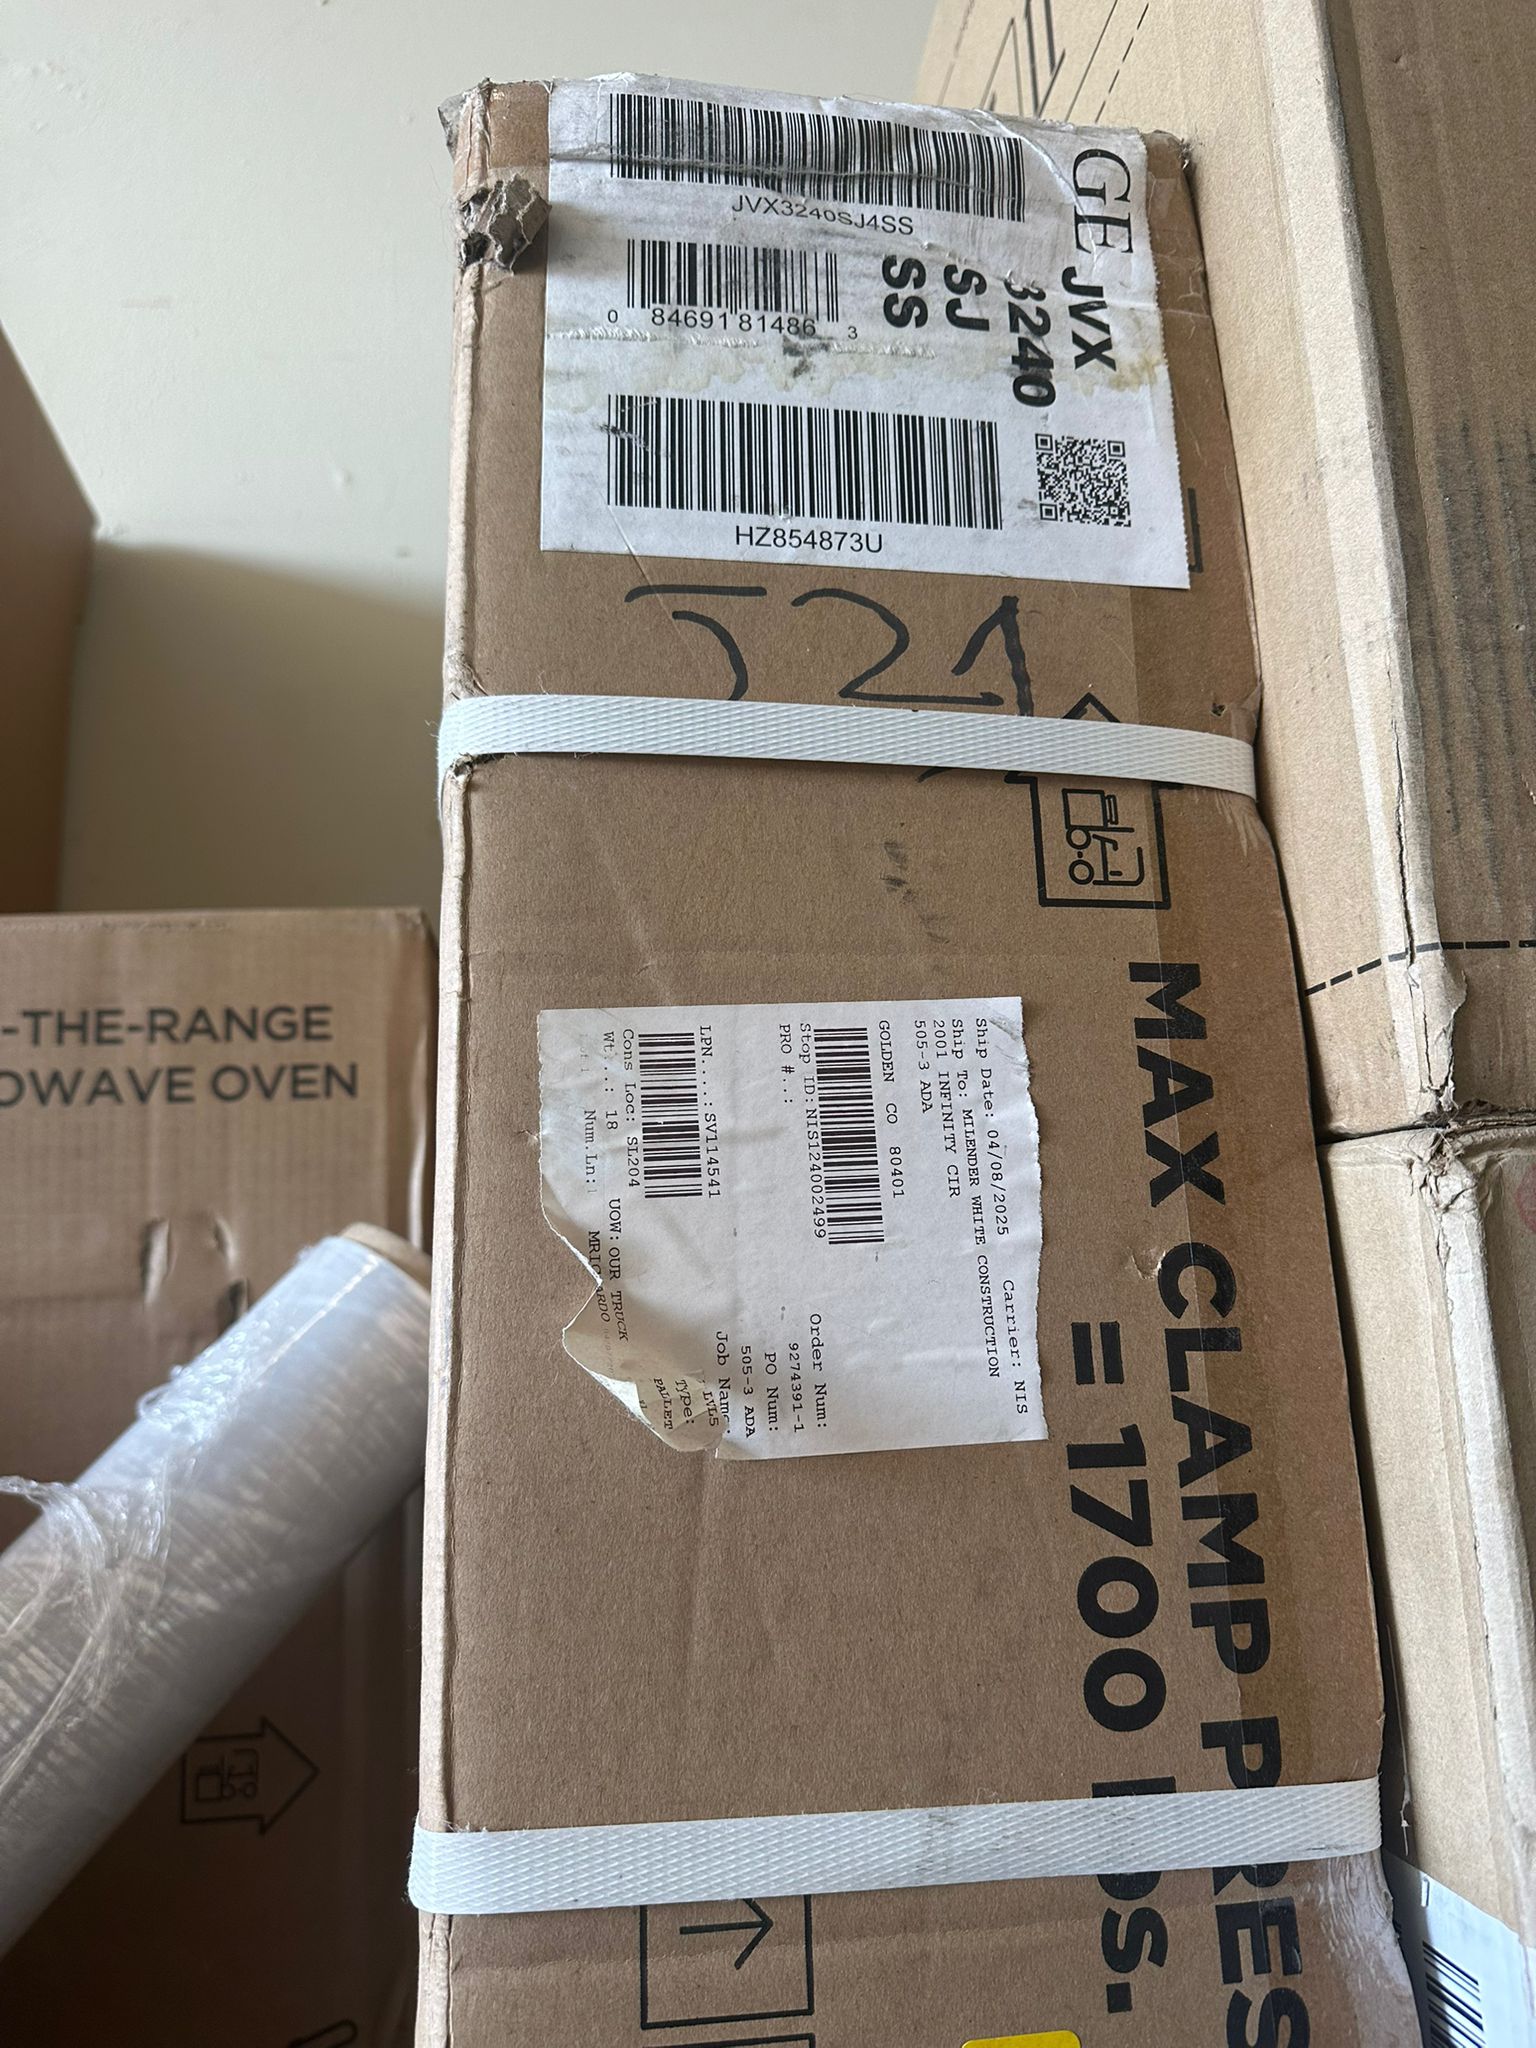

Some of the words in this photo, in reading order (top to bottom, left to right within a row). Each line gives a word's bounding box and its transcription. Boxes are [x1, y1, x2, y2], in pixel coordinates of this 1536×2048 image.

[732, 195, 914, 236] JVX3240SJ4SS
[1073, 148, 1133, 254] GE
[882, 254, 929, 328] SS
[943, 263, 990, 332] SJ
[607, 309, 619, 324] 0
[651, 308, 728, 330] 84691
[738, 313, 817, 336] 81486
[847, 326, 858, 339] 3
[1004, 270, 1056, 407] 3240
[1061, 267, 1116, 371] JVX
[735, 525, 884, 555] HZ854873U
[623, 1028, 634, 1071] Cons
[779, 1023, 792, 1054] PRO
[799, 1022, 812, 1064] Stop
[879, 1019, 895, 1083] GOLDEN
[914, 1019, 930, 1070] 505-3
[933, 1019, 946, 1059] 2001
[951, 1018, 964, 1060] Ship
[976, 1018, 988, 1059] Ship
[211, 1062, 359, 1101] OVEN
[625, 1083, 636, 1122] Loc:
[919, 1080, 932, 1114] ADA
[956, 1070, 969, 1098] To:
[980, 1068, 995, 1118] Date:
[1128, 963, 1226, 1207] MAX
[605, 1110, 618, 1130] 18
[886, 1102, 898, 1124] CO
[938, 1072, 957, 1154] INFINITY
[627, 1136, 640, 1188] SL204
[890, 1146, 905, 1199] 80401
[962, 1109, 980, 1187] MILENDER
[947, 1164, 960, 1198] CIR
[987, 1129, 1009, 1236] 04/08/2025
[971, 1195, 986, 1246] WHITE
[611, 1290, 629, 1342] TRUCK
[977, 1254, 1000, 1378] CONSTRUCTION
[1002, 1279, 1022, 1368] Carrier:
[716, 1331, 729, 1366] Job
[764, 1352, 777, 1375] PO
[810, 1313, 824, 1371] Order
[741, 1345, 754, 1395] 505-3
[788, 1342, 805, 1433] 9274391-1
[654, 1377, 673, 1430] PALLET
[702, 1391, 719, 1427] LVL5
[744, 1405, 756, 1438] ADA
[766, 1386, 780, 1432] Num:
[814, 1383, 828, 1428] Num:
[1014, 1380, 1028, 1414] NIS
[1157, 1241, 1272, 1678] CLAMP
[1067, 1425, 1168, 1735] 1700
